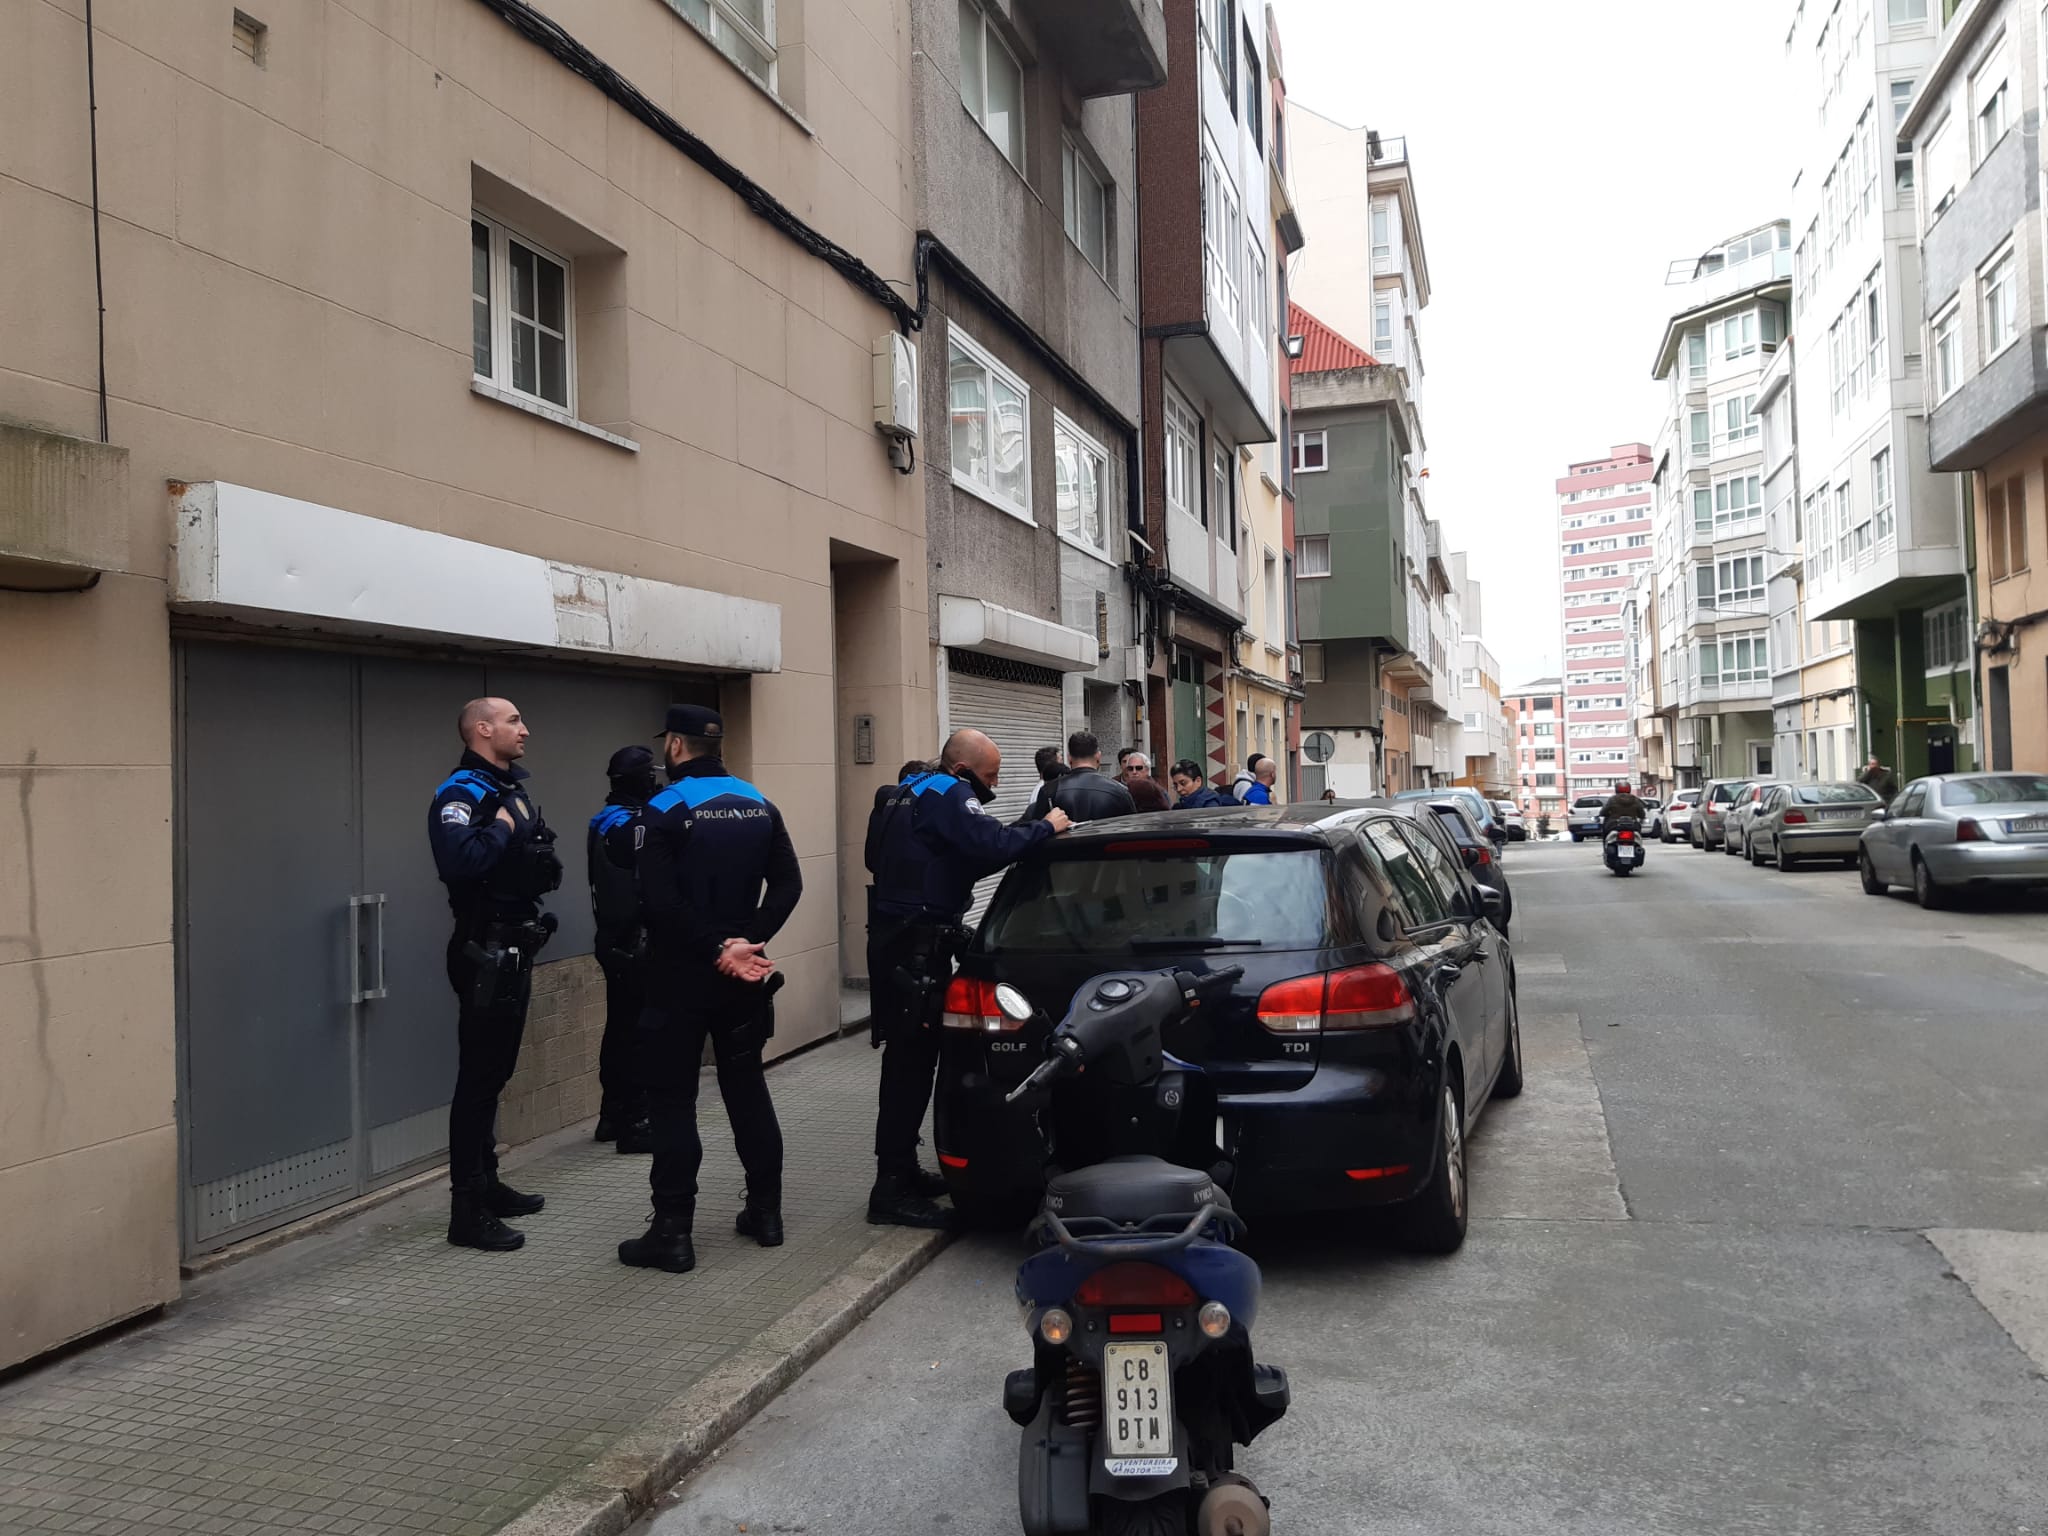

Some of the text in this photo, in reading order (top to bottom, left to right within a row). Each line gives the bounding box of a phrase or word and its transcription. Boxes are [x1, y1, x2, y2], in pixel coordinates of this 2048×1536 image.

[696, 808, 768, 819] POLICÍA LOCAL
[991, 1042, 1027, 1052] GOLF
[1282, 1042, 1310, 1053] TDI
[1124, 1359, 1149, 1381] C8
[1117, 1388, 1158, 1410] 913
